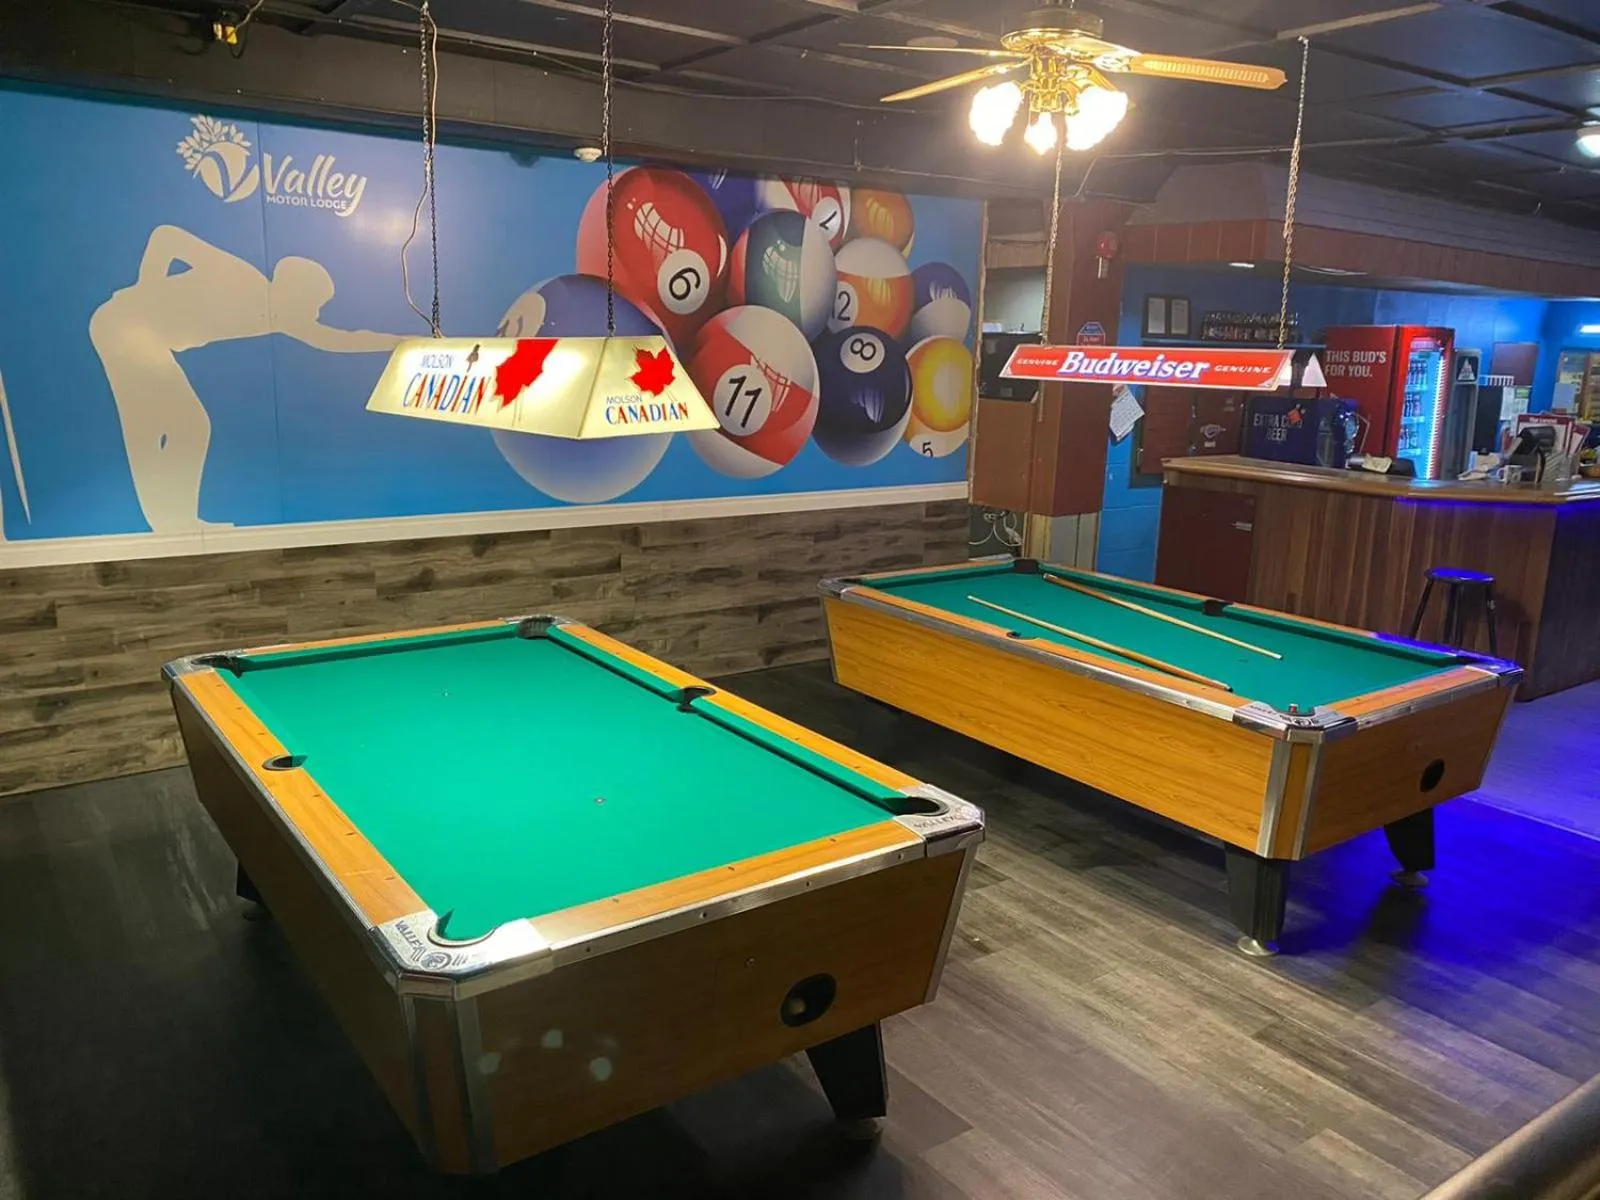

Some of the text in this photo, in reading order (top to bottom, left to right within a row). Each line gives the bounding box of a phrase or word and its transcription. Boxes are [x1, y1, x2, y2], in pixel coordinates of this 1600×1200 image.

[263, 153, 367, 217] Valley
[266, 195, 347, 210] MOTOR LODGE
[668, 267, 701, 301] 6
[850, 338, 877, 361] 8
[1325, 351, 1387, 364] THIS BUD'S
[1016, 351, 1273, 379] GENUINE Budweiser GENUINE
[1325, 365, 1373, 378] FOR YOU.
[403, 372, 491, 414] CANADIAN
[606, 395, 643, 405] MOLSON
[725, 375, 763, 428] 11
[605, 402, 690, 425] CANADIAN
